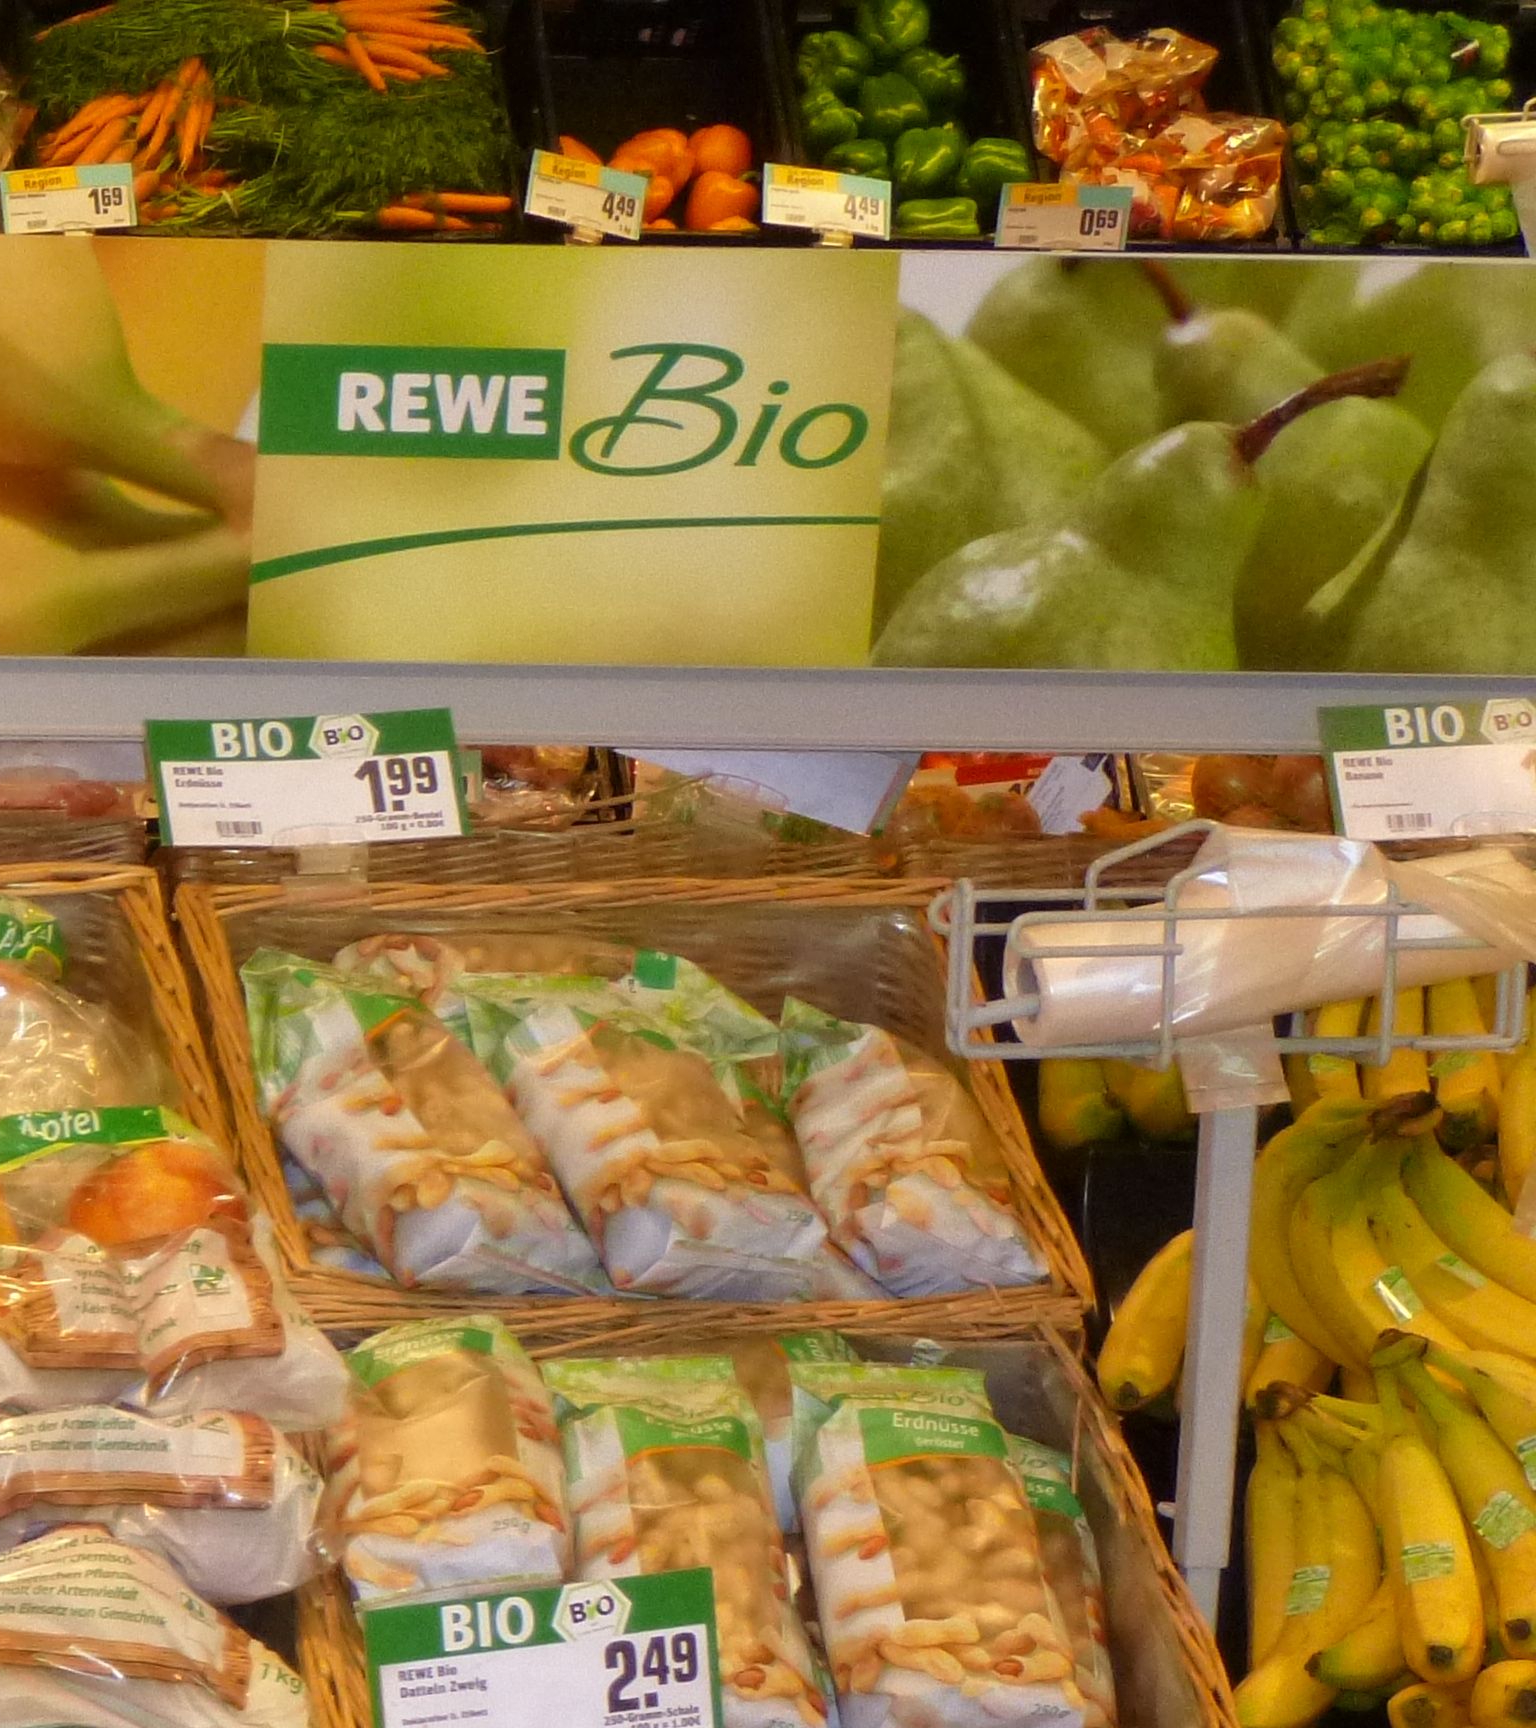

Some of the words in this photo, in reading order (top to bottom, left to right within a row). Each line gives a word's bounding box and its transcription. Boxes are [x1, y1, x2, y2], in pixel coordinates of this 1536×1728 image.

[23, 176, 62, 190] Region
[88, 187, 123, 215] 1.69
[602, 192, 636, 221] 4.49
[844, 194, 879, 221] 4.49
[1080, 209, 1118, 236] 0.69
[338, 372, 548, 435] REWE
[568, 343, 869, 476] Bio
[1384, 705, 1464, 745] BIO
[212, 721, 293, 758] BIO
[354, 756, 439, 813] 1.99
[892, 1412, 979, 1437] Erdnüsse
[441, 1596, 534, 1651] BIO
[398, 1667, 433, 1681] REWE
[438, 1665, 457, 1677] Bio
[605, 1632, 699, 1713] 2.49
[399, 1682, 447, 1699] Datteln
[450, 1677, 487, 1692] Zweig
